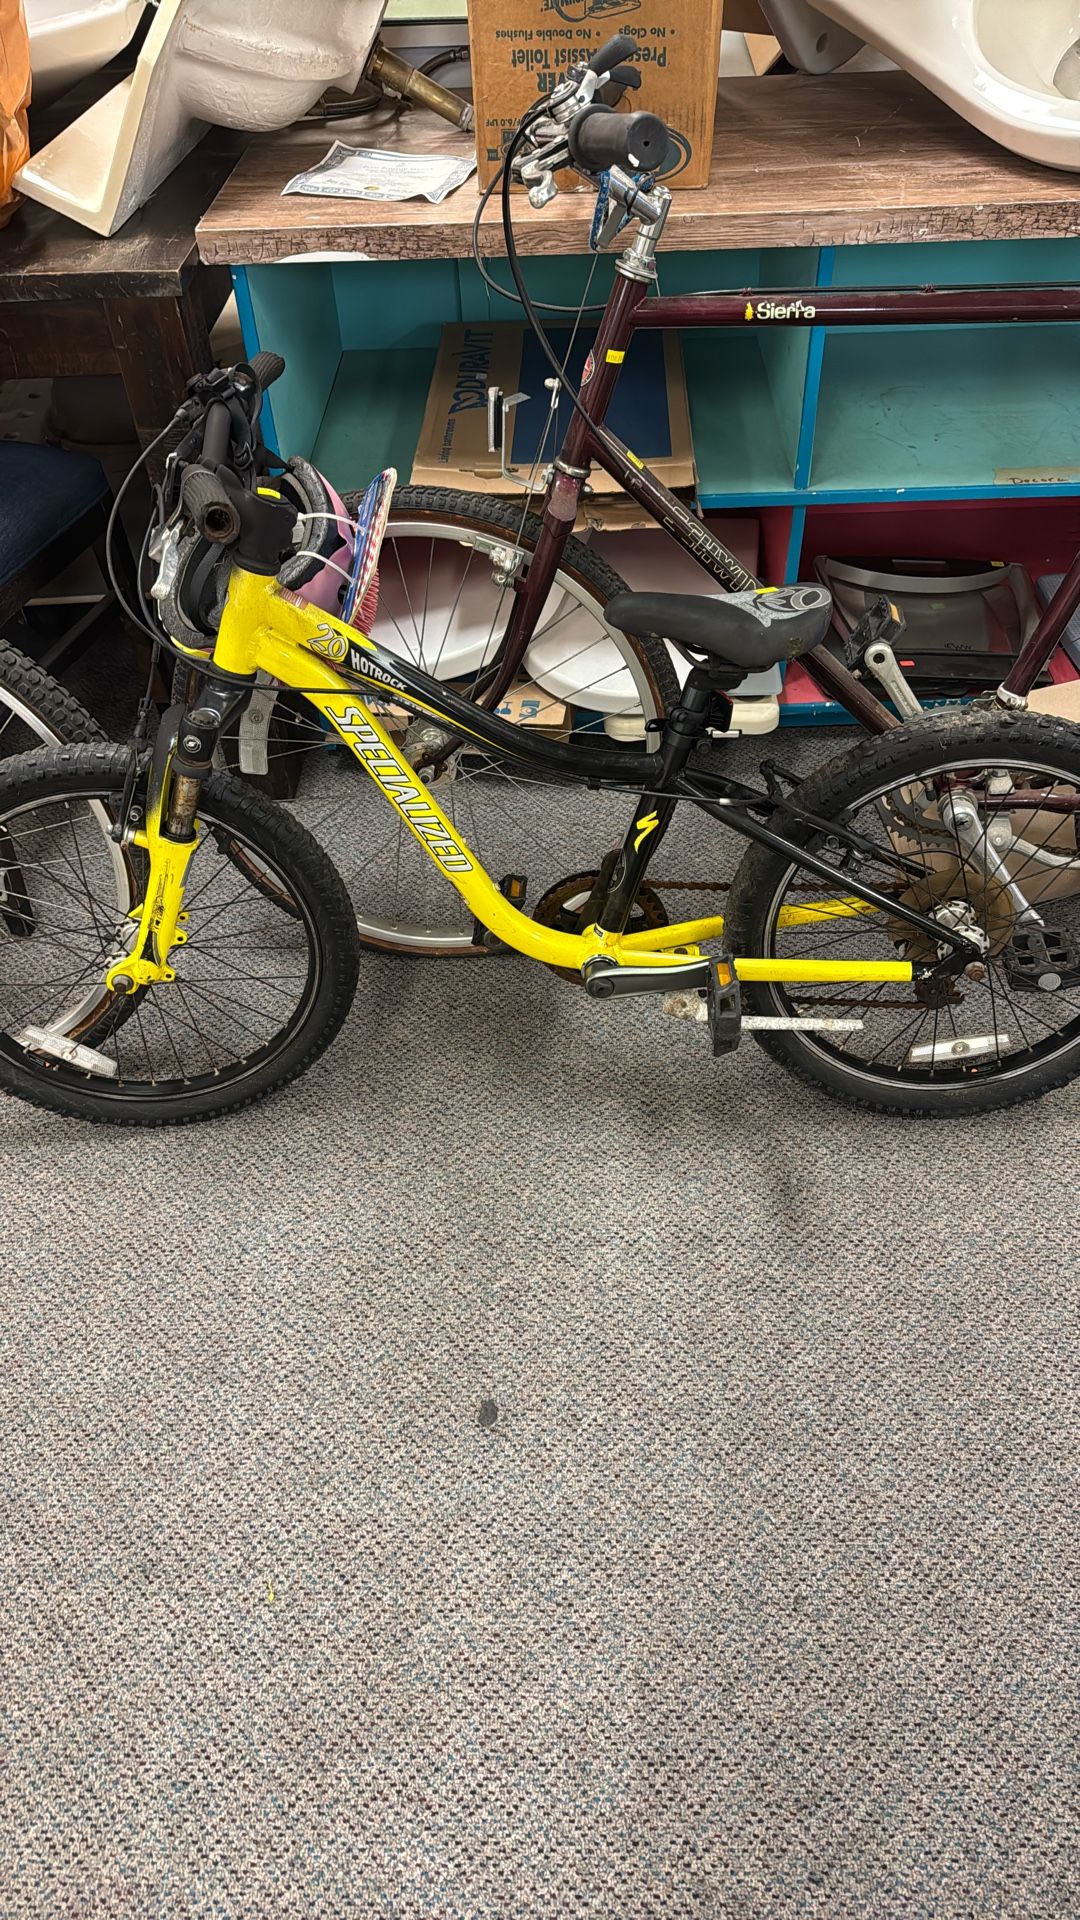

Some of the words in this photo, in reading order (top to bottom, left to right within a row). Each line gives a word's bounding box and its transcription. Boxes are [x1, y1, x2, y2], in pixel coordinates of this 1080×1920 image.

[495, 29, 533, 41] Flushes
[536, 29, 572, 41] Double
[576, 29, 591, 40] No
[618, 25, 647, 39] Clogs
[650, 27, 666, 38] No
[511, 48, 550, 71] Toilet
[555, 48, 597, 67] Assist
[486, 118, 499, 127] LPF
[756, 300, 816, 320] Sierra
[452, 328, 494, 389] DURAVIT
[307, 623, 347, 657] 20
[350, 647, 408, 691] HOTROCK
[324, 706, 473, 872] SPECIALIZED
